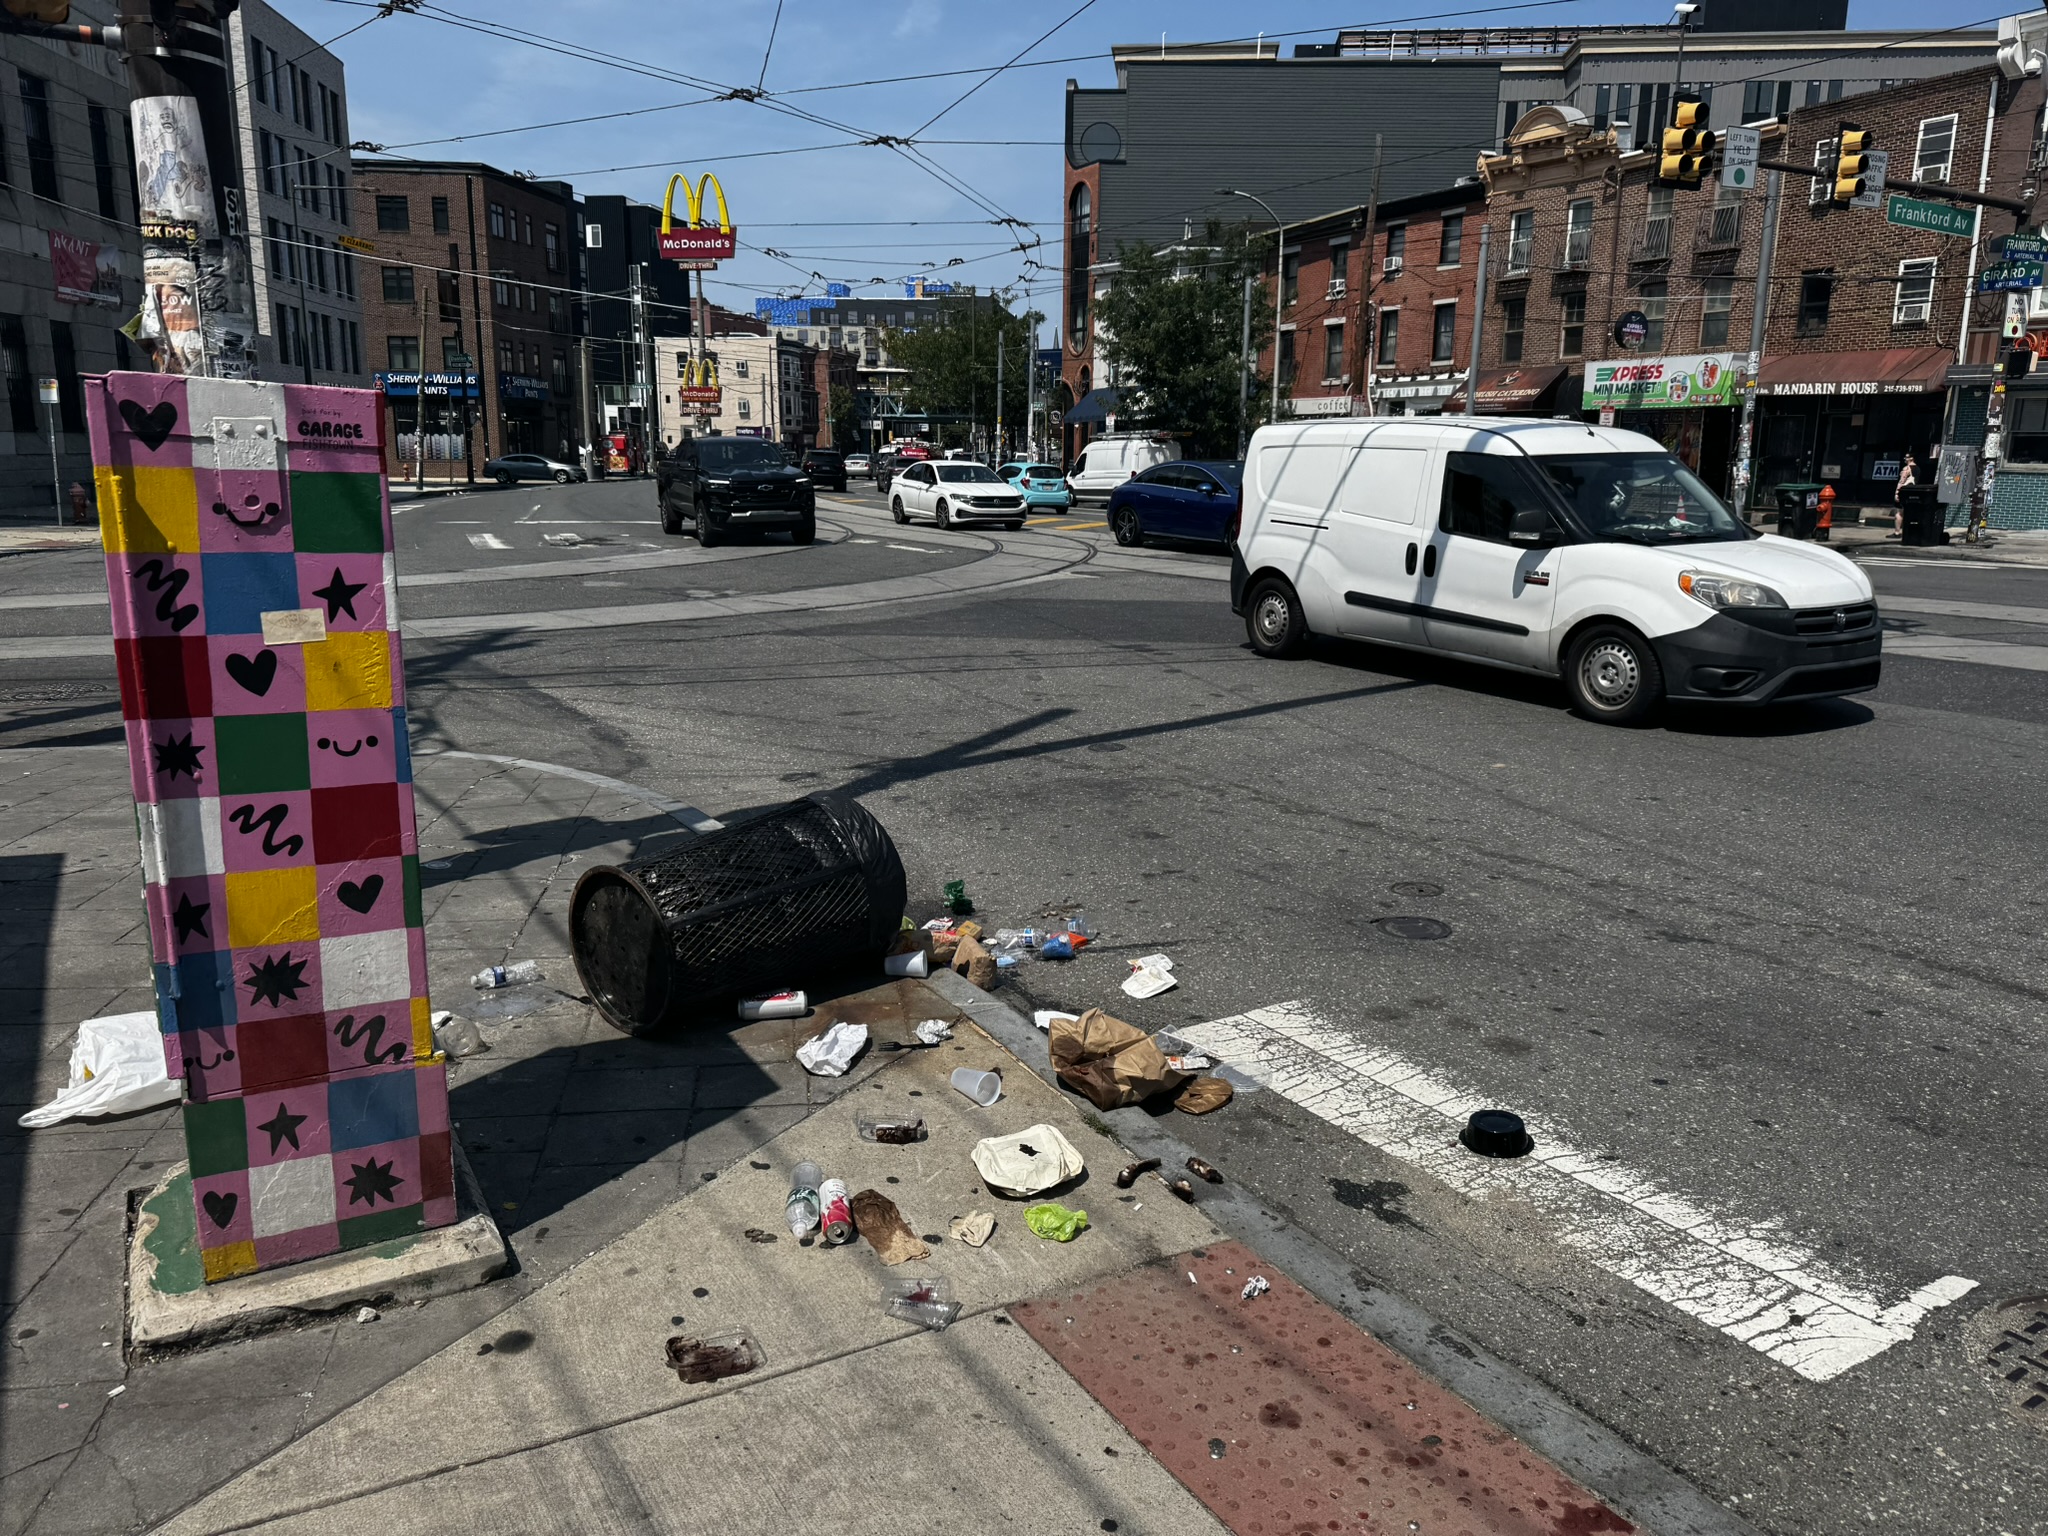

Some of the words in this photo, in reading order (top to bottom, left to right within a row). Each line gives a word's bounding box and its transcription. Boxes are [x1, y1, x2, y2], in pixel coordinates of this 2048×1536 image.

[1734, 145, 1751, 156] YIELD
[1867, 164, 1883, 173] AFFIC
[1895, 203, 1951, 227] Frankford
[1953, 215, 1968, 230] Av
[663, 239, 730, 249] McDonald's
[2006, 239, 2041, 252] FRANKFORD
[2006, 251, 2011, 259] S
[2014, 252, 2035, 260] ARTERIAL
[1983, 267, 2026, 282] GIRARD
[2030, 268, 2040, 277] AV
[1994, 280, 2023, 288] ARTERIAL
[2014, 298, 2023, 306] NO
[2012, 307, 2025, 315] TURN
[2007, 316, 2014, 324] ON
[1596, 364, 1664, 382] EXPRESS
[387, 373, 476, 385] SHERWN-WILLIAMS
[417, 385, 448, 395] AINTS
[1593, 385, 1613, 396] MINI
[1615, 382, 1656, 394] MARKET
[1774, 382, 1836, 395] MANDARIN
[1840, 382, 1878, 394] HOUSE
[298, 421, 363, 438] GARAGE
[302, 438, 354, 450] FISHTOWN
[1874, 466, 1899, 476] ATM
